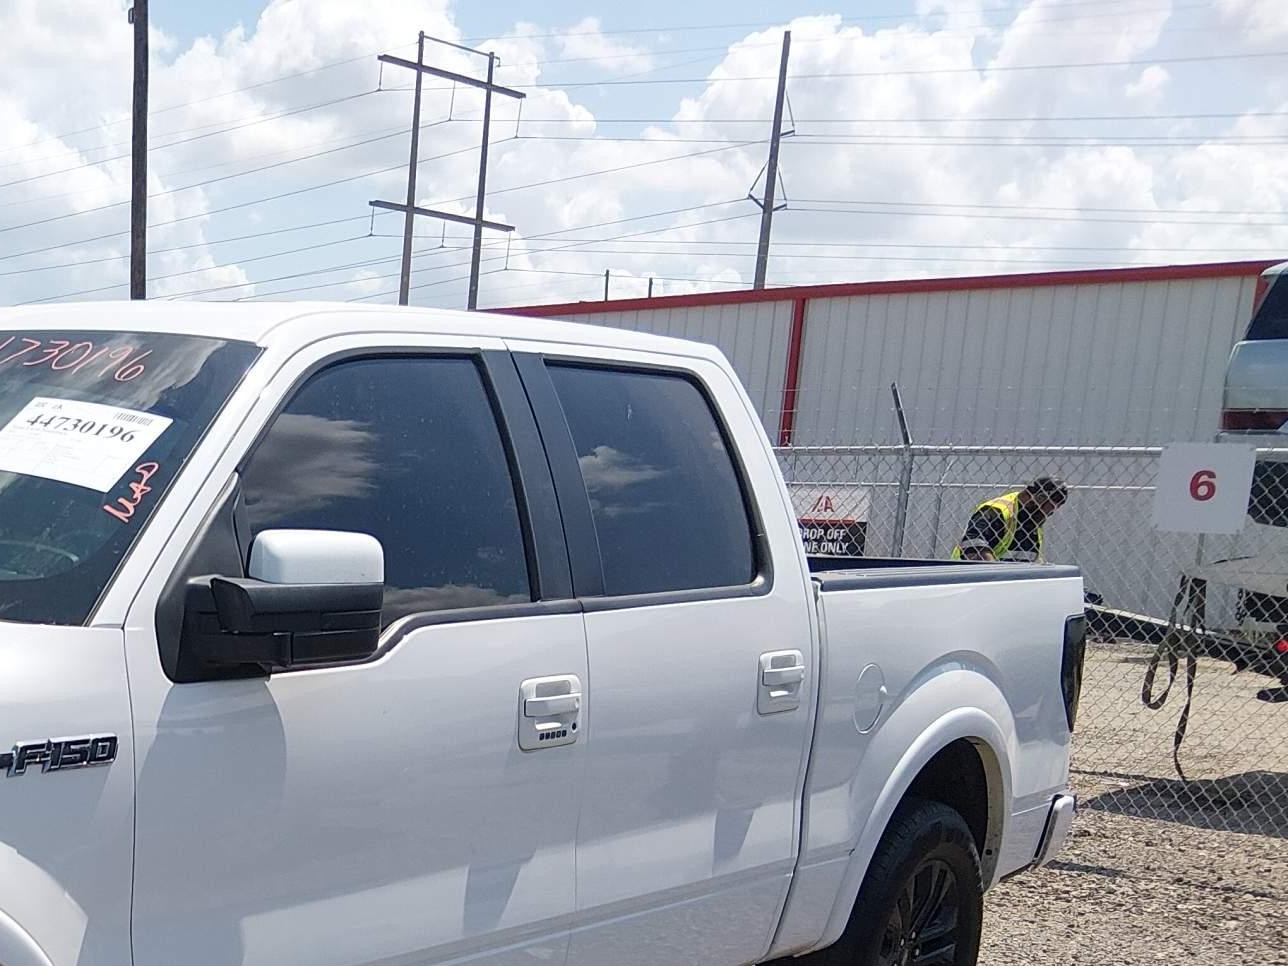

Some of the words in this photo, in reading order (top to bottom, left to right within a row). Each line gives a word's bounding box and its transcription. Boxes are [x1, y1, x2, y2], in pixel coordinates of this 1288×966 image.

[26, 413, 136, 443] 44730196
[1189, 469, 1217, 501] 6
[827, 528, 846, 540] OFF
[820, 542, 849, 553] ONLY
